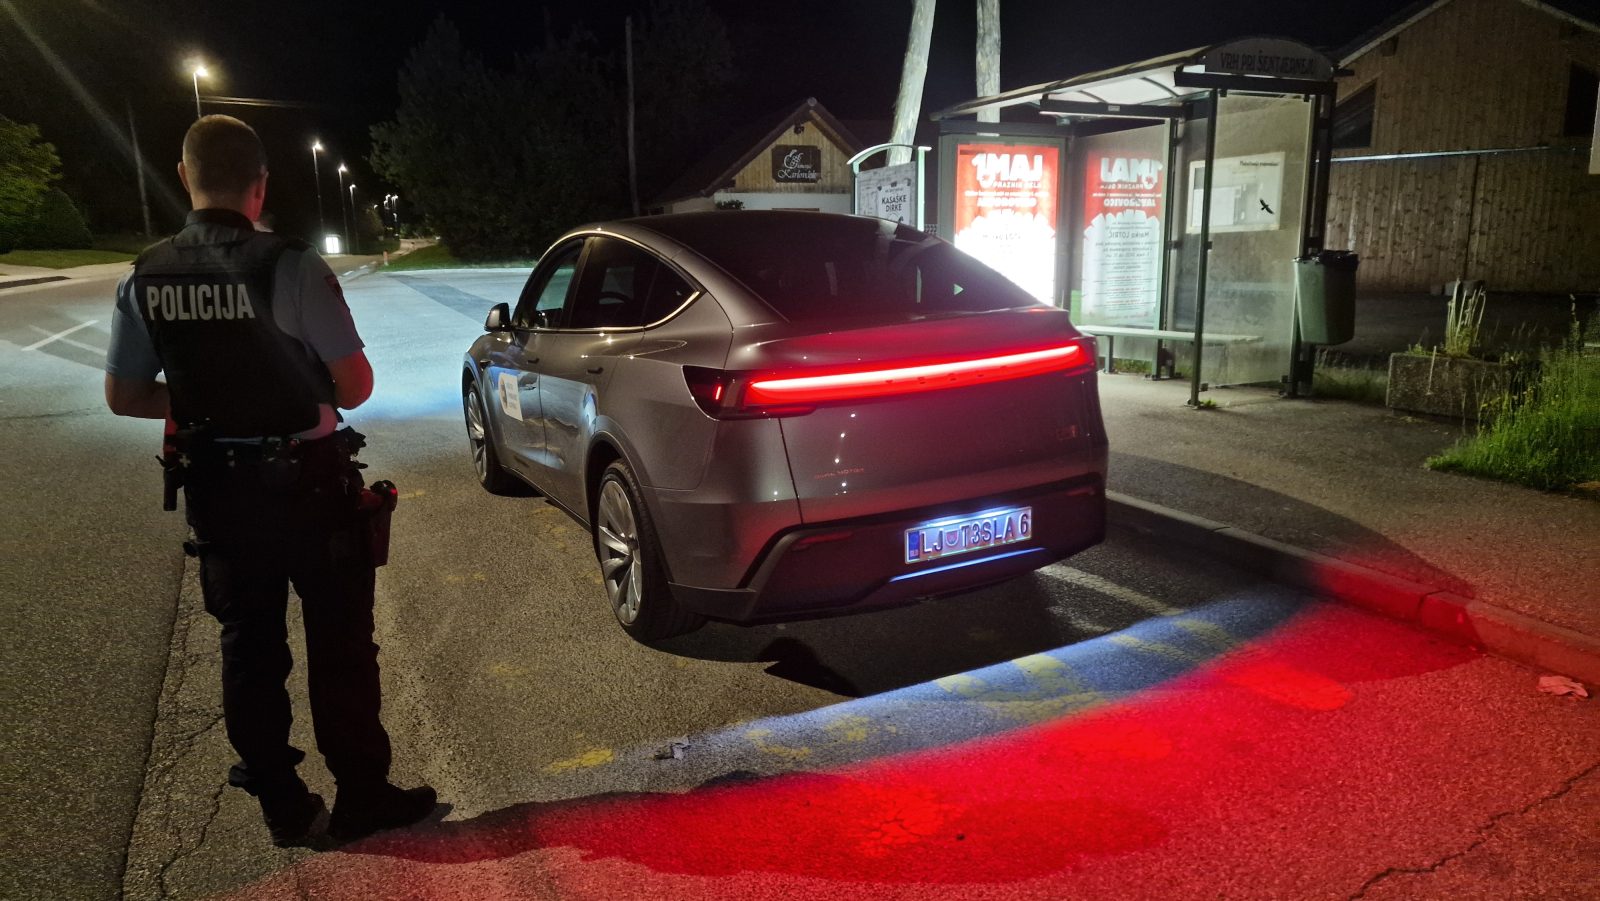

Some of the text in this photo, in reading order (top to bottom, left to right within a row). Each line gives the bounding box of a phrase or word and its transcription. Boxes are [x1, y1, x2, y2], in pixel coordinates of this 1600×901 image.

[1221, 52, 1239, 69] VRH
[1241, 53, 1255, 71] PRI
[885, 204, 902, 212] DIRKE
[146, 283, 256, 321] POLICIJA
[921, 528, 944, 554] LJ
[960, 515, 1015, 548] T3SLA
